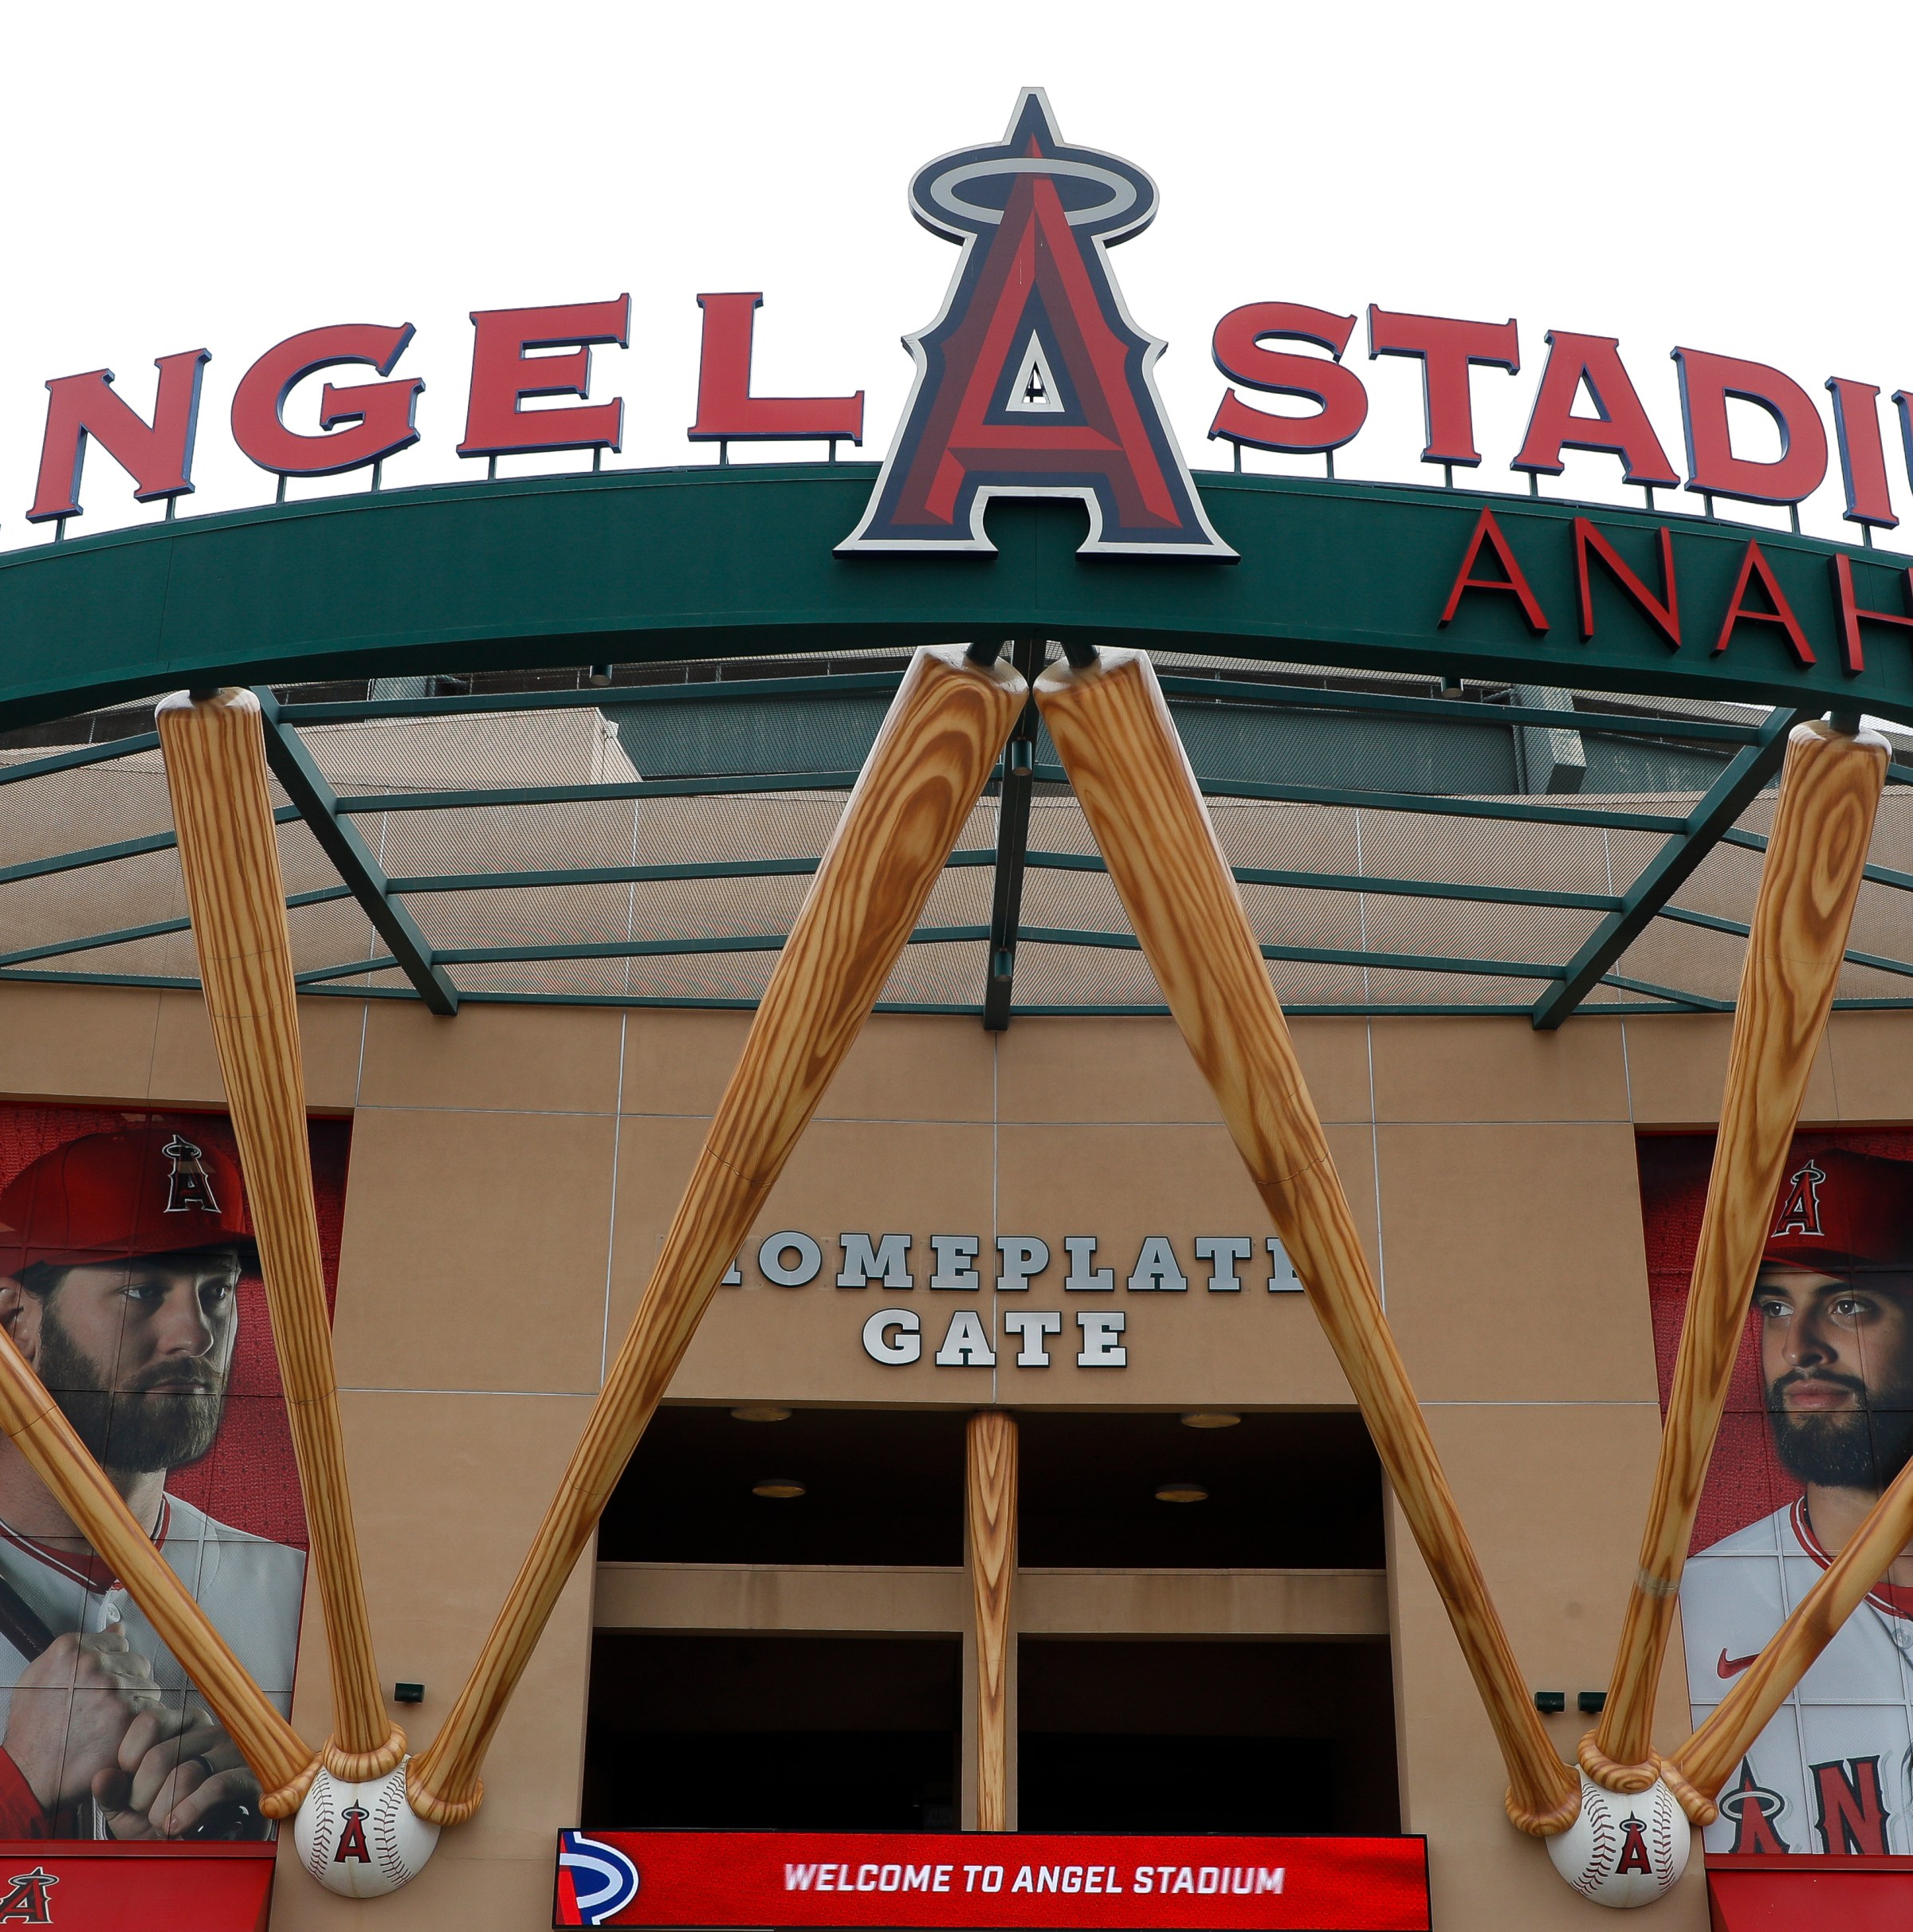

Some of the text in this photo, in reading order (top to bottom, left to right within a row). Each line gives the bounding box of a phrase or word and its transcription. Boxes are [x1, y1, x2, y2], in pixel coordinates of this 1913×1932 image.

[832, 87, 1241, 565] A
[1207, 300, 1913, 529] STADI
[163, 1134, 222, 1213] A
[1771, 1159, 1826, 1238] A
[862, 1308, 1127, 1368] GATE
[333, 1798, 372, 1863] A
[1614, 1810, 1653, 1875] A
[784, 1863, 1285, 1895] WELCOME TO ANGEL STADIUM
